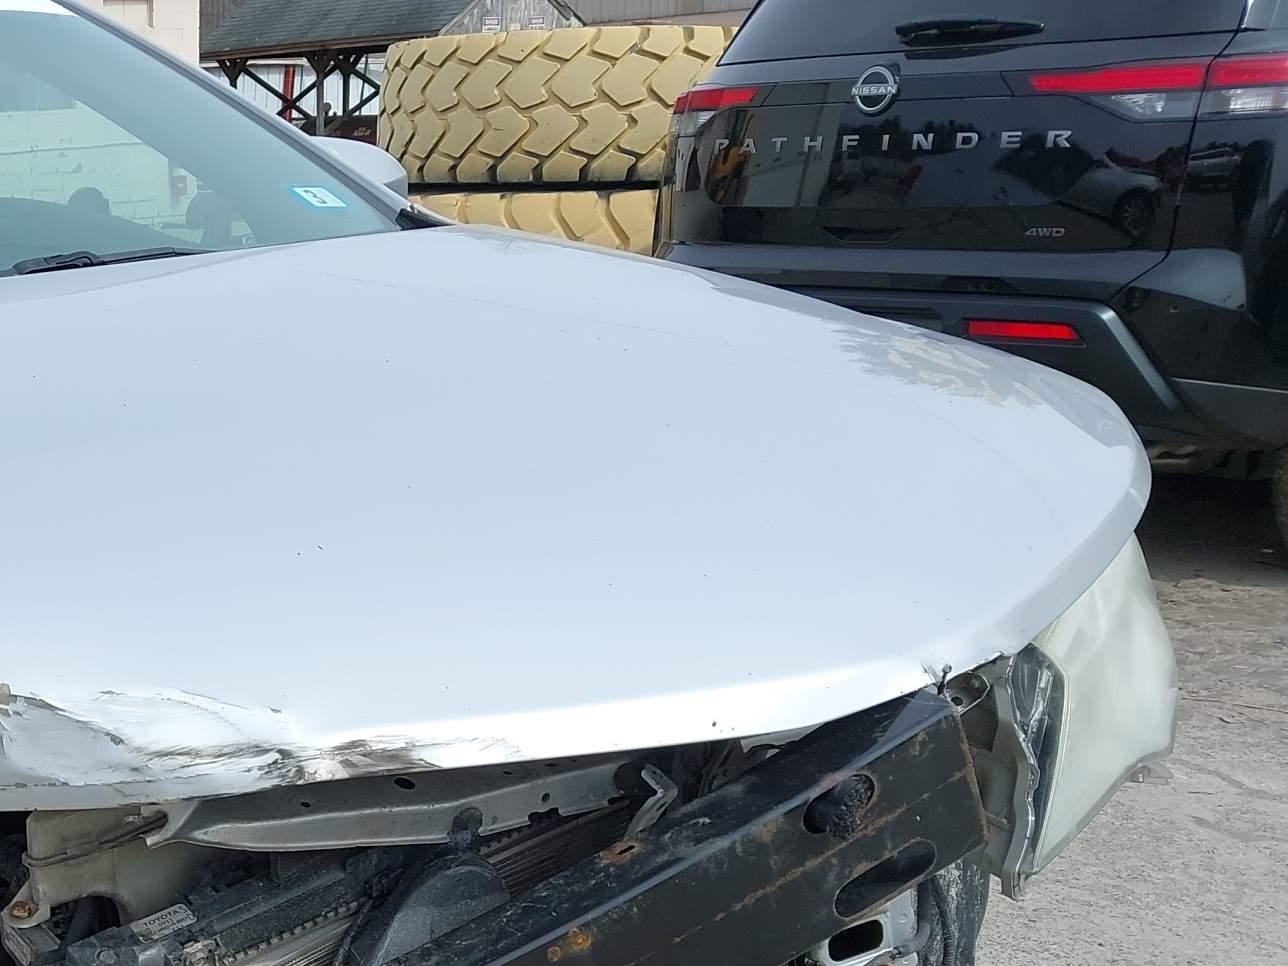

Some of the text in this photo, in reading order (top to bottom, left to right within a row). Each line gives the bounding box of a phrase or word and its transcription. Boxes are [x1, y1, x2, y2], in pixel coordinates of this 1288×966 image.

[851, 84, 897, 96] NISSAN
[714, 129, 1073, 154] PATHFINDER
[1024, 227, 1065, 237] 4WD
[143, 910, 180, 927] TOYOTA
